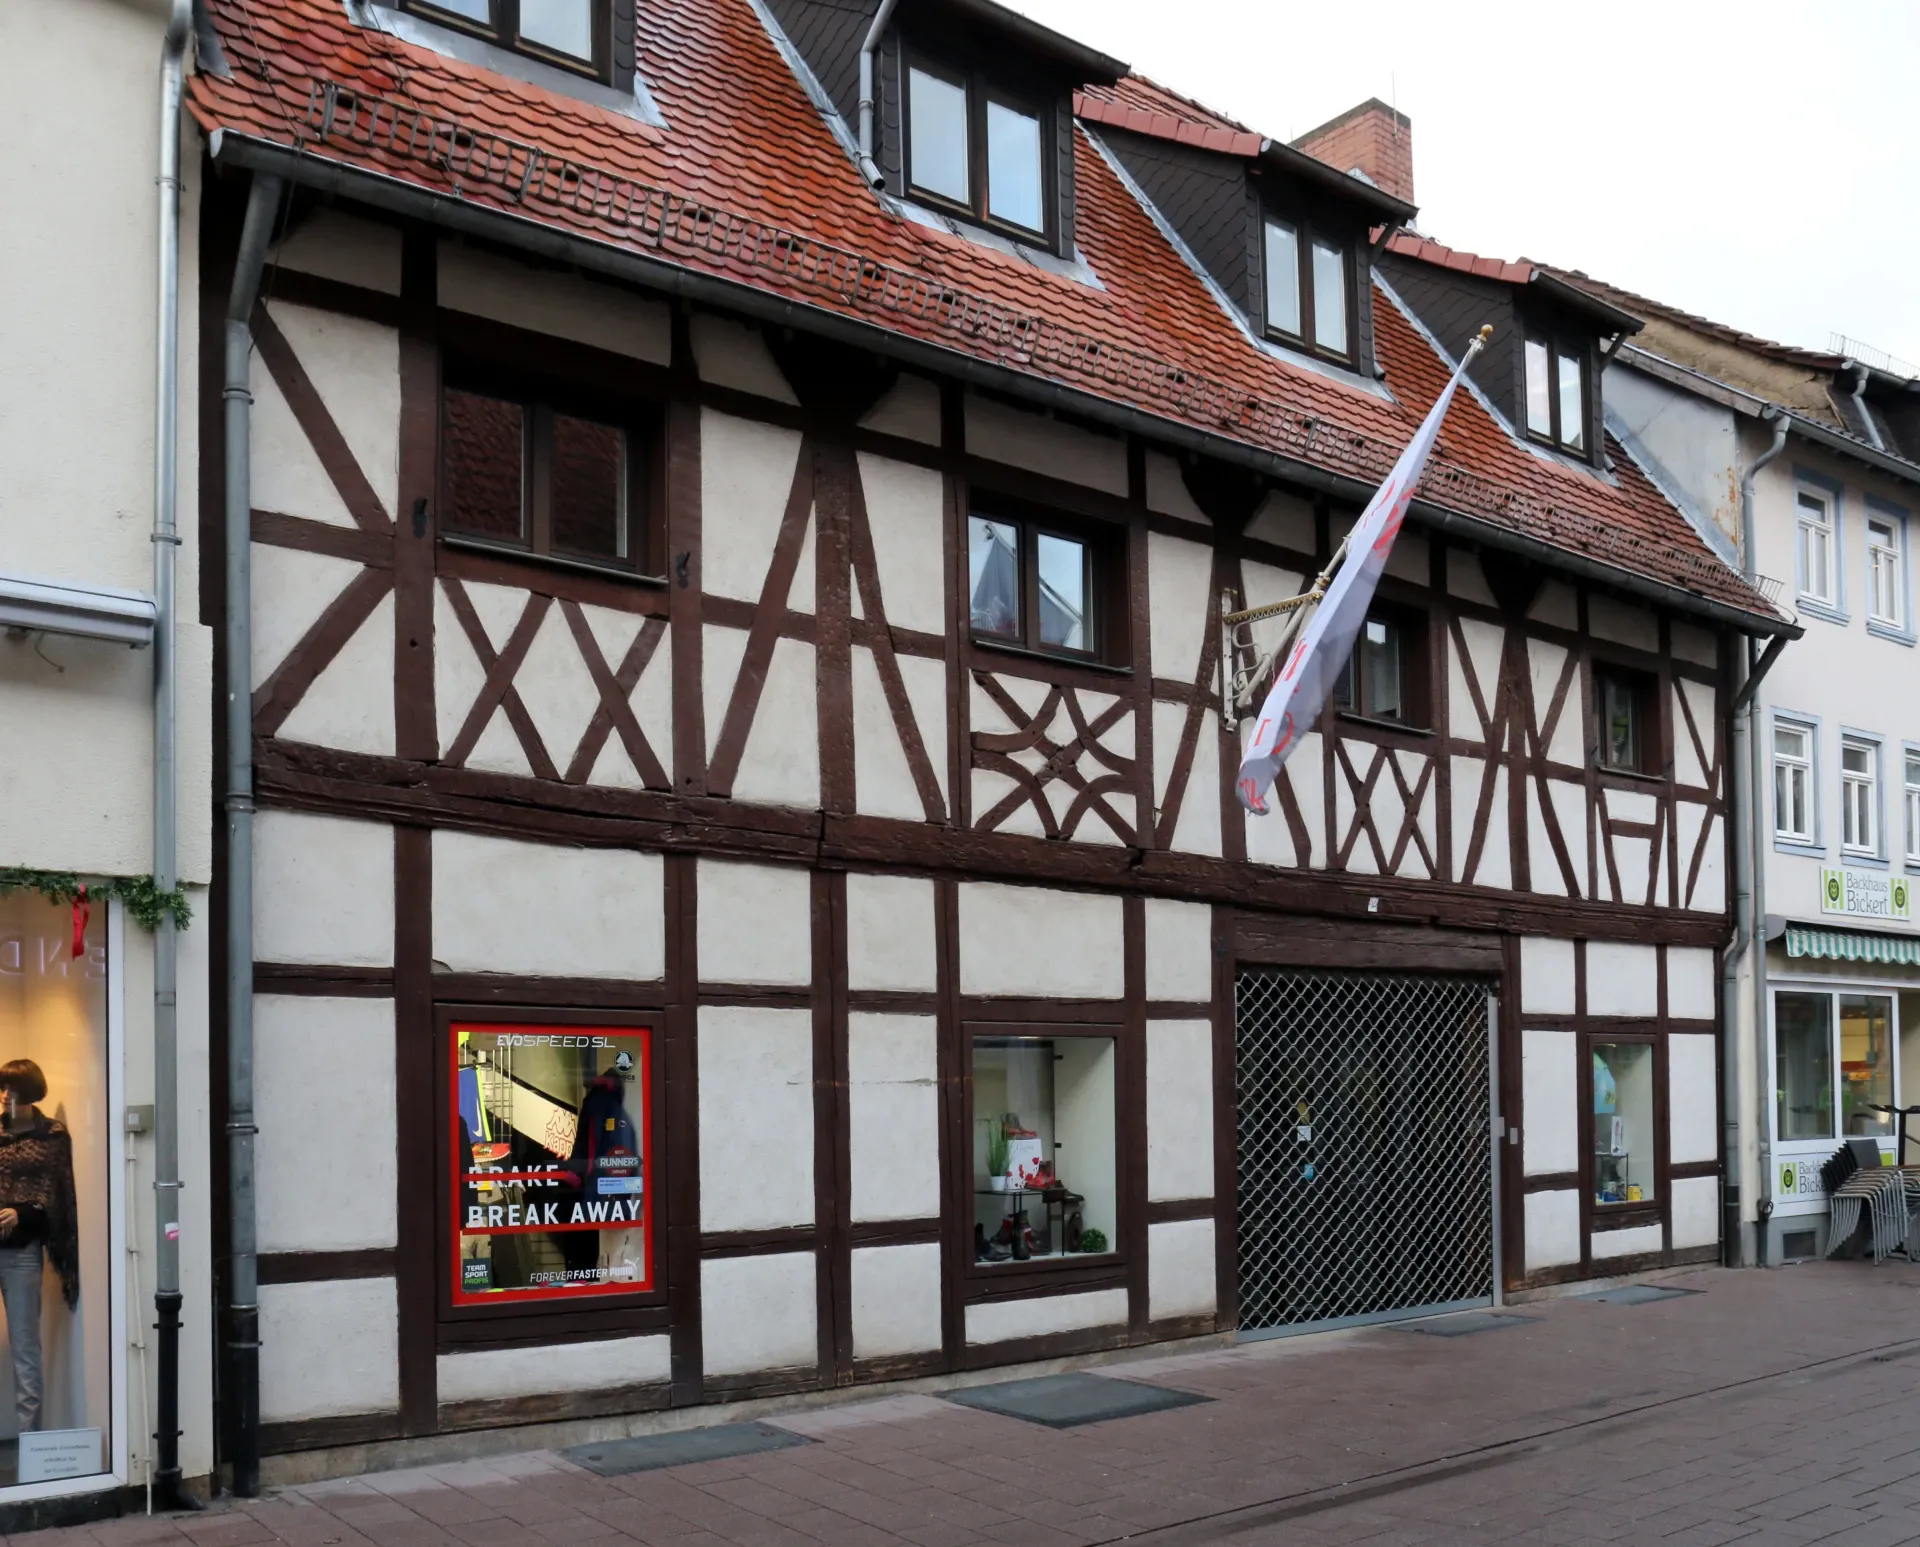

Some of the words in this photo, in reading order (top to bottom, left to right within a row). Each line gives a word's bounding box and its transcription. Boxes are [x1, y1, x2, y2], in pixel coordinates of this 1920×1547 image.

[1846, 871, 1888, 892] Backhaus
[1846, 890, 1888, 914] Bickert
[592, 1036, 616, 1048] SL
[544, 1131, 574, 1160] Kapp
[1799, 1175, 1826, 1193] Bicke
[468, 1202, 559, 1228] BREAK
[570, 1199, 641, 1223] AWAY
